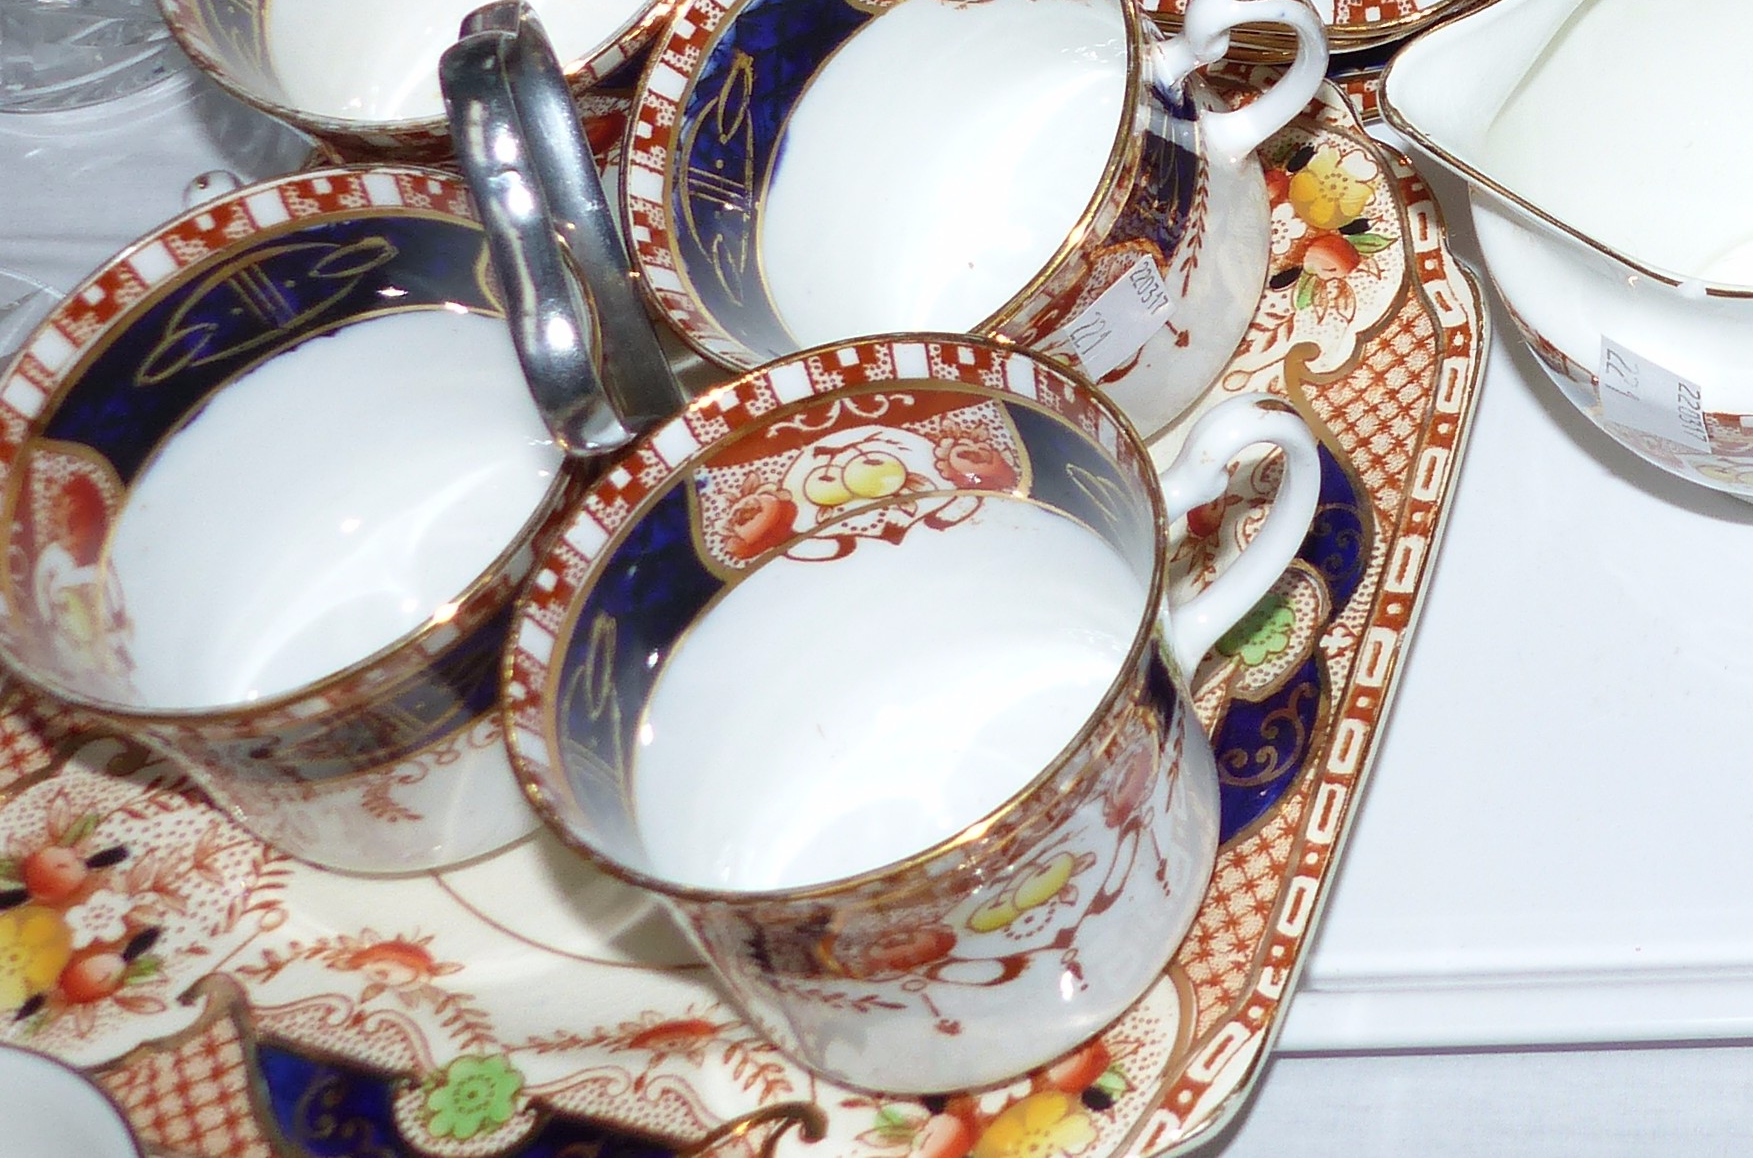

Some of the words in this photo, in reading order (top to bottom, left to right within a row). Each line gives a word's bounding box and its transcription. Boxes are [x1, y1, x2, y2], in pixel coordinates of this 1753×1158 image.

[1129, 261, 1169, 316] 220317
[1069, 311, 1112, 355] 221
[1604, 348, 1640, 402] 221
